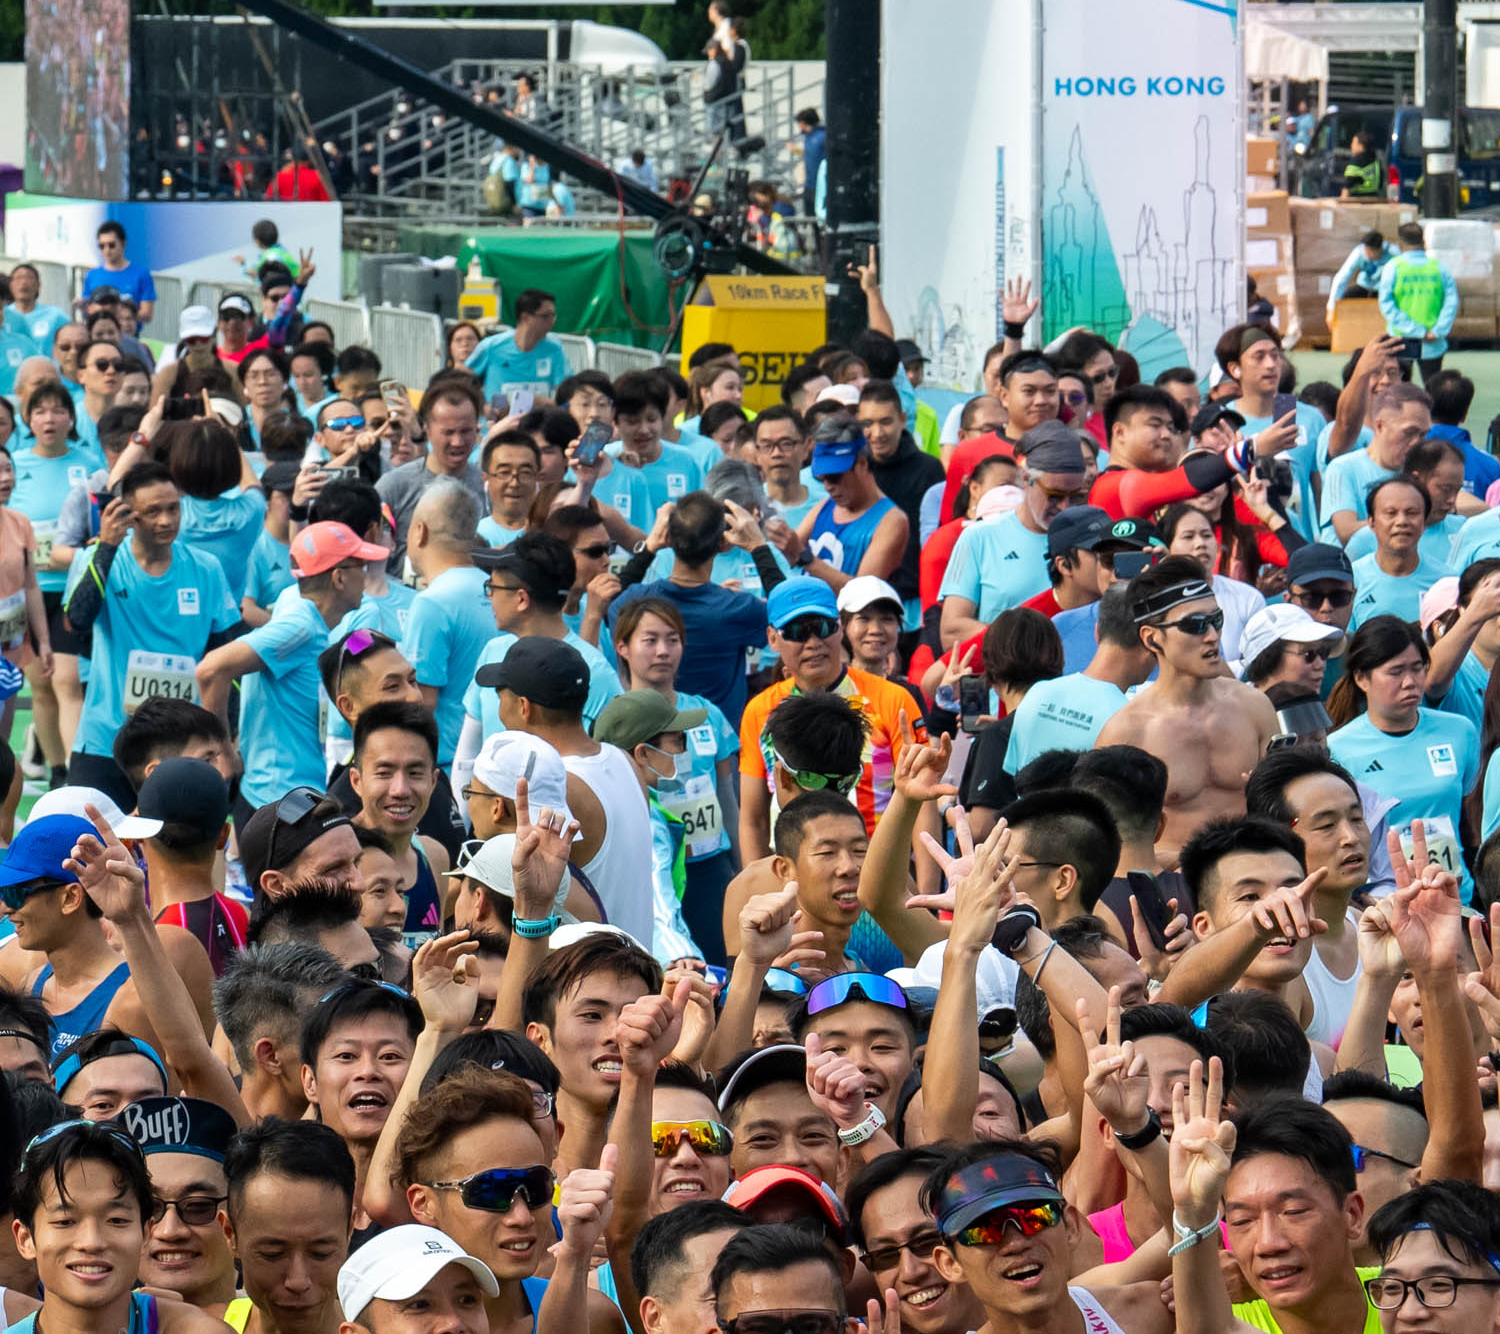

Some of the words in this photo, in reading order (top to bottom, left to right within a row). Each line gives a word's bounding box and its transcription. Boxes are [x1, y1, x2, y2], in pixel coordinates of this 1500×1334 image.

[1055, 77, 1136, 96] HONG
[1147, 77, 1225, 95] KONG
[728, 283, 768, 301] 10km
[772, 283, 807, 300] Race
[131, 674, 194, 703] U0314
